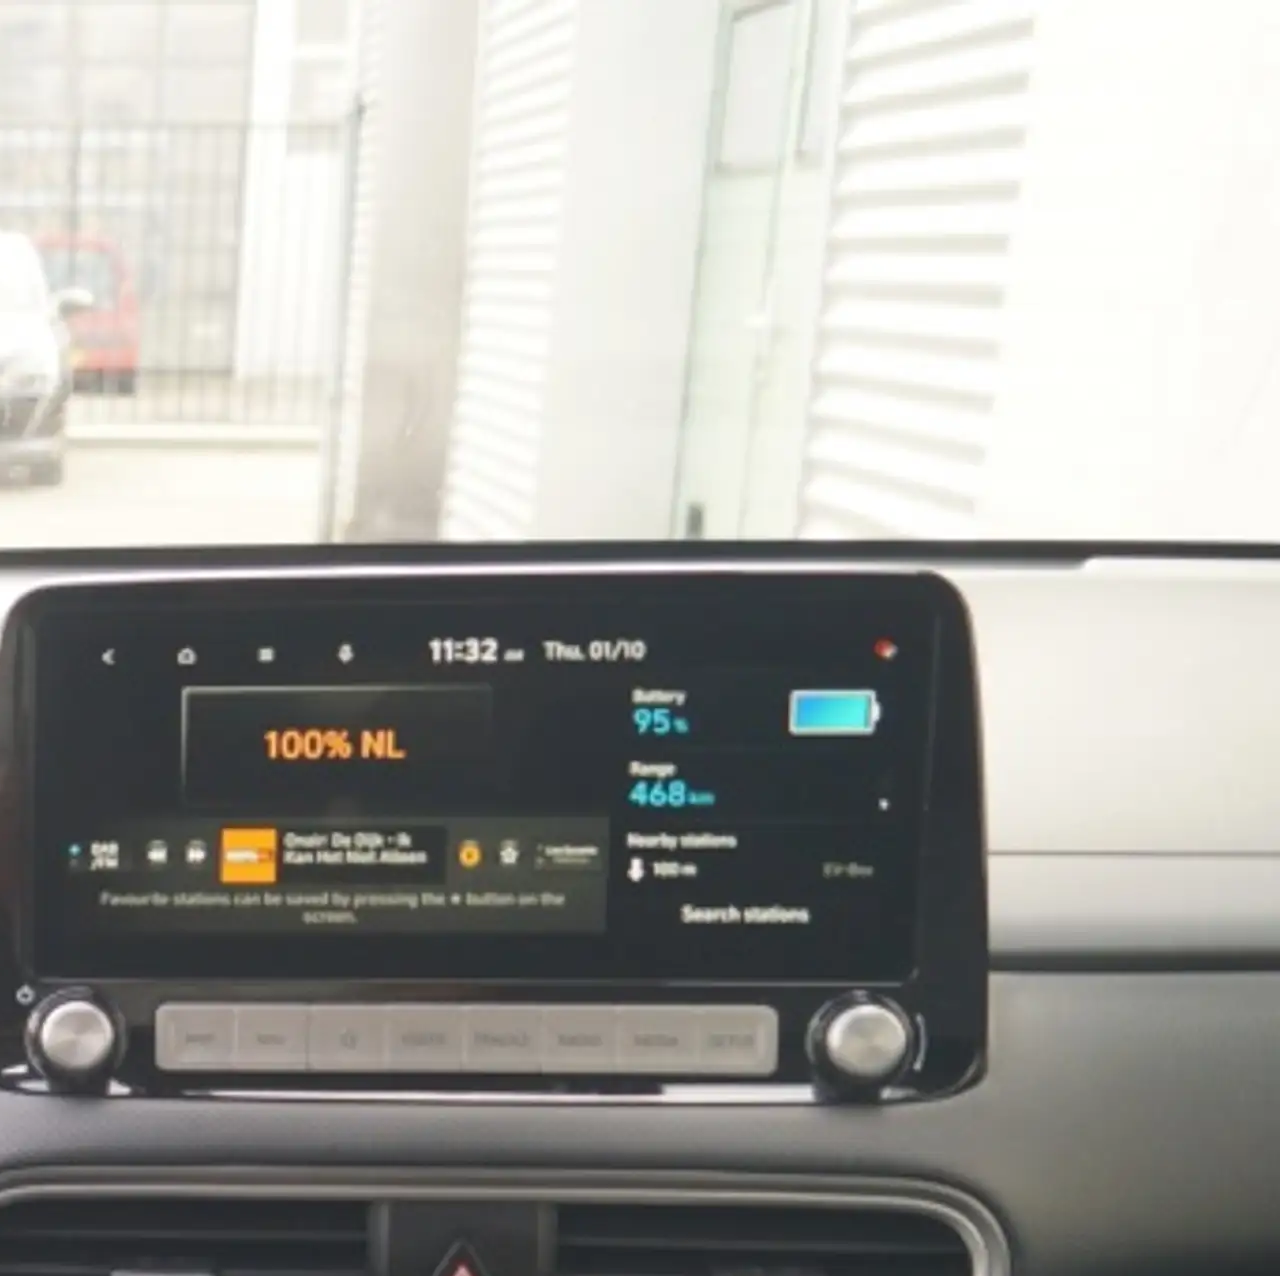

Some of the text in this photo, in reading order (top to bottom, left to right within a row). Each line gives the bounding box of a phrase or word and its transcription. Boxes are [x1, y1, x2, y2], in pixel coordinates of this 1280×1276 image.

[429, 637, 498, 663] 11:32
[590, 638, 647, 661] 01/10
[631, 688, 687, 706] Battery
[265, 729, 406, 760] 100% NL
[628, 760, 676, 778] Range
[330, 831, 351, 848] De
[627, 832, 737, 850] Nearby stations
[316, 850, 343, 865] Het
[100, 891, 168, 907] Favourite
[172, 891, 231, 907] stations
[234, 894, 261, 906] can
[264, 892, 283, 906] be
[285, 892, 329, 907] saved
[331, 892, 351, 909] by
[353, 893, 418, 909] pressing
[421, 892, 445, 907] the
[465, 892, 515, 907] button
[540, 891, 566, 906] the
[681, 903, 810, 923] Search stations
